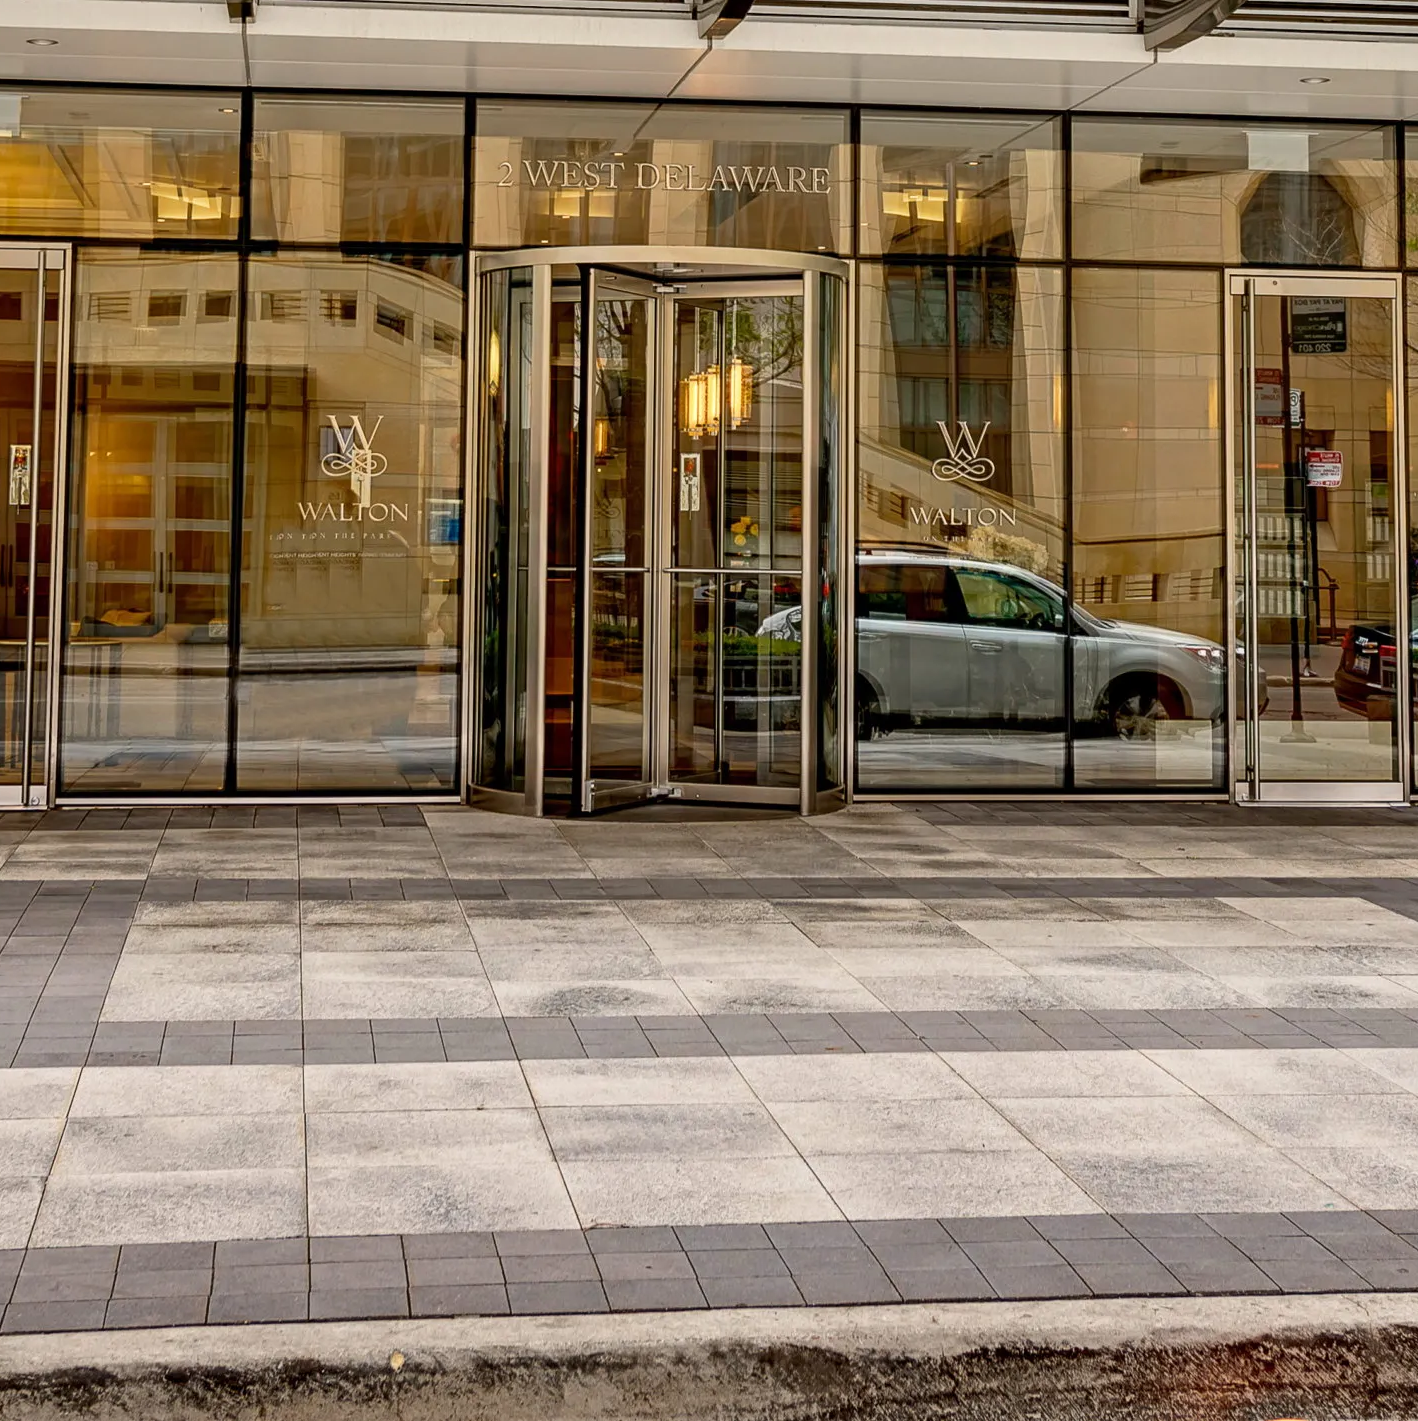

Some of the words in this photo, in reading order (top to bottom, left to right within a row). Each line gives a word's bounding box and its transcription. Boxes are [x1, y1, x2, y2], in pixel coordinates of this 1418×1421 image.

[497, 162, 513, 187] 2
[523, 160, 625, 191] WEST
[633, 162, 831, 195] DELAWARE
[297, 502, 408, 522] WALTON
[910, 507, 1016, 526] WALTON
